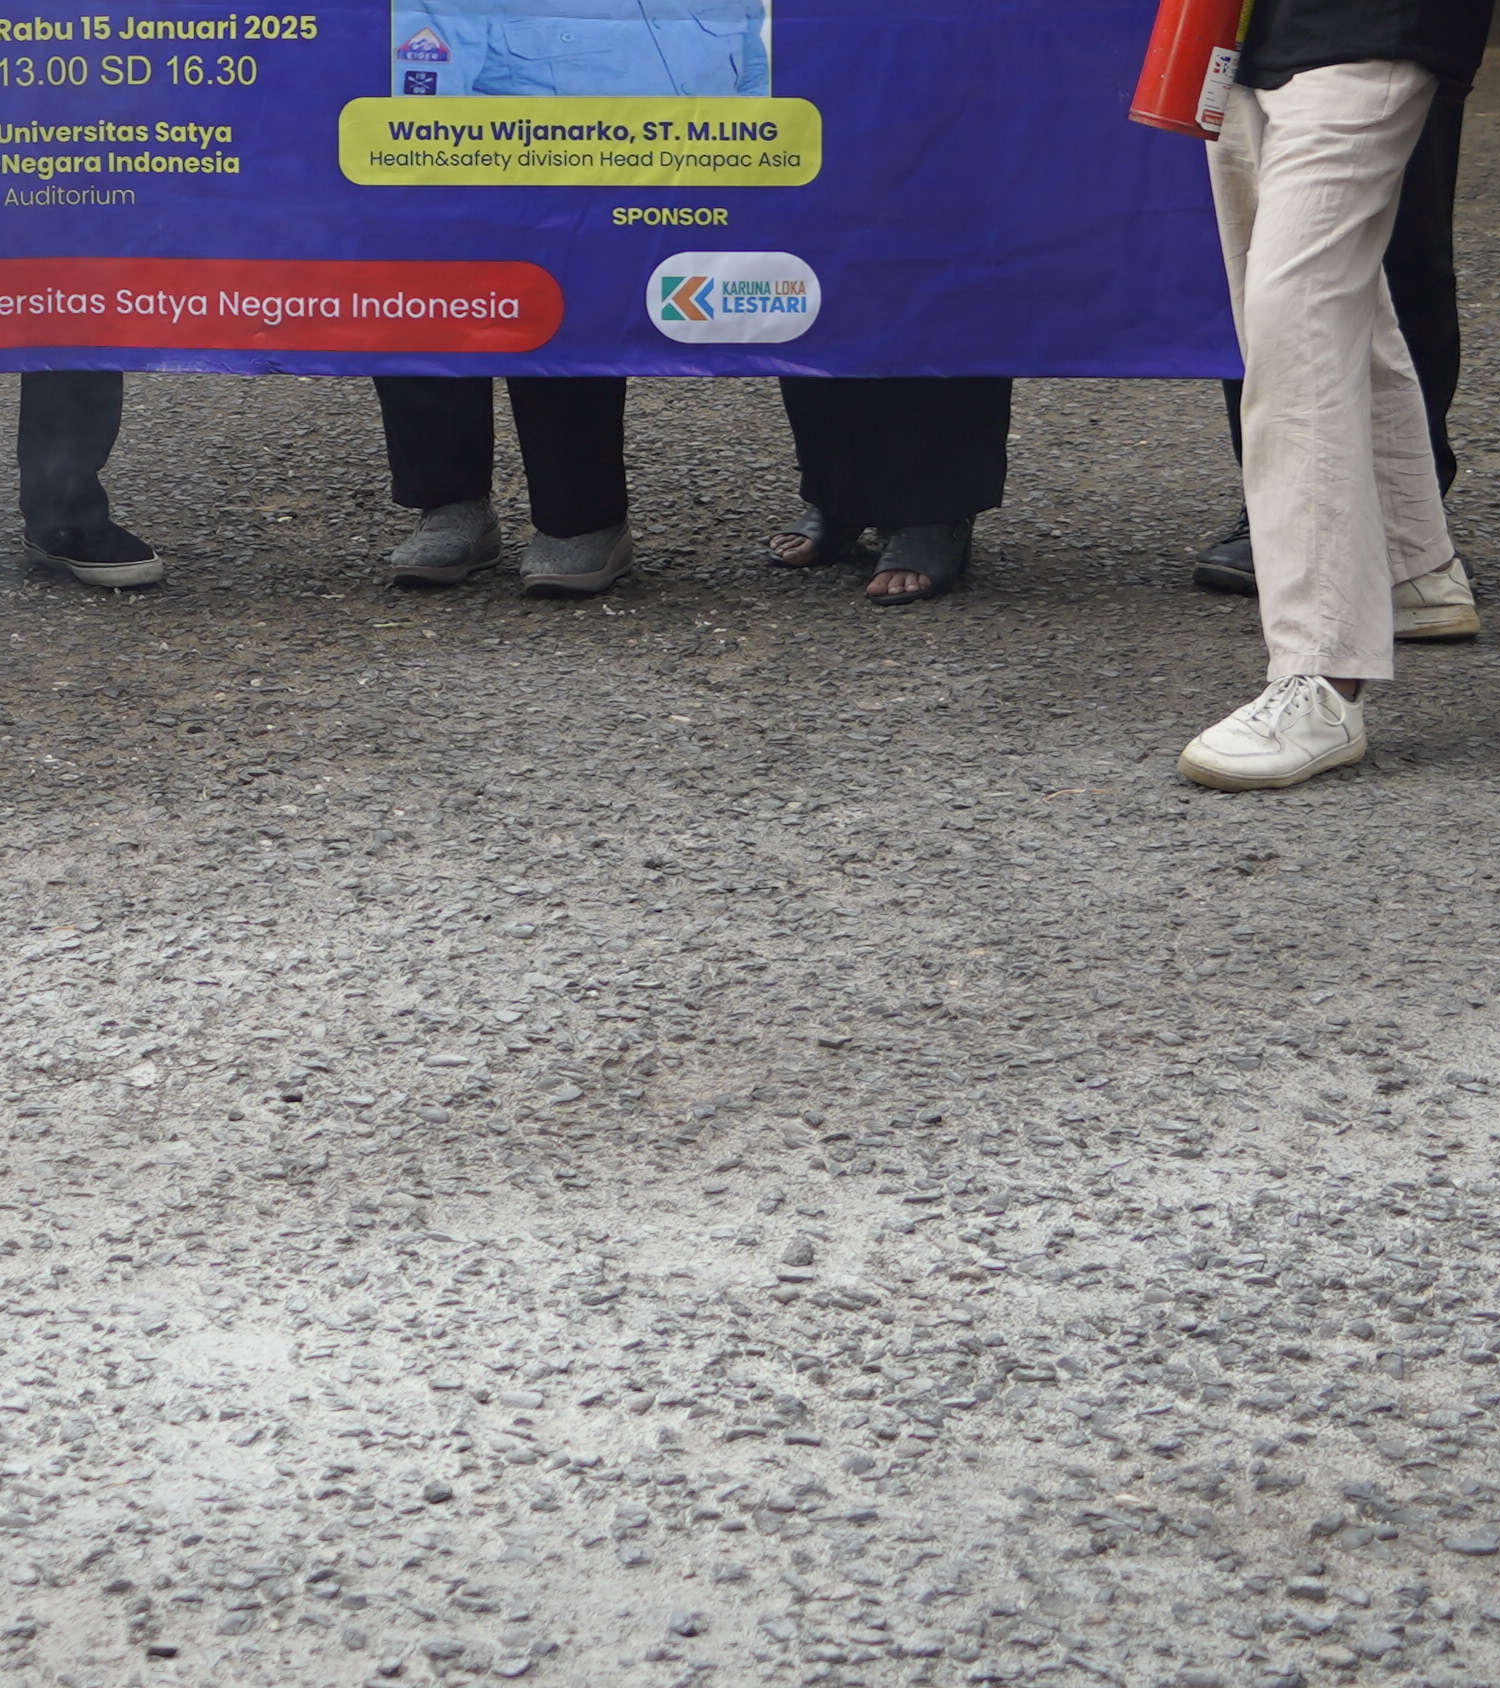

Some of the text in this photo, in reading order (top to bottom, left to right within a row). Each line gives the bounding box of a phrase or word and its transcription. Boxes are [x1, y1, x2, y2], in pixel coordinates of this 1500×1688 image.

[80, 15, 111, 40] 15
[118, 13, 237, 40] Januari
[244, 15, 318, 40] 2025
[100, 55, 152, 86] SD
[166, 55, 257, 86] 16.30
[155, 121, 232, 150] Satya
[388, 118, 778, 148] Wahyu Wijanarko, ST. M.LING
[1, 150, 240, 181] Negara Indonesia
[370, 149, 801, 172] Health&safety division Head Dynapac Asia
[4, 184, 135, 207] Auditorium
[612, 207, 729, 226] SPONSOR
[722, 280, 806, 295] KARUNA LOKA
[116, 289, 207, 324] Satya
[219, 290, 340, 326] Negara
[352, 291, 519, 319] Indonesia
[722, 296, 807, 313] LESTARI
